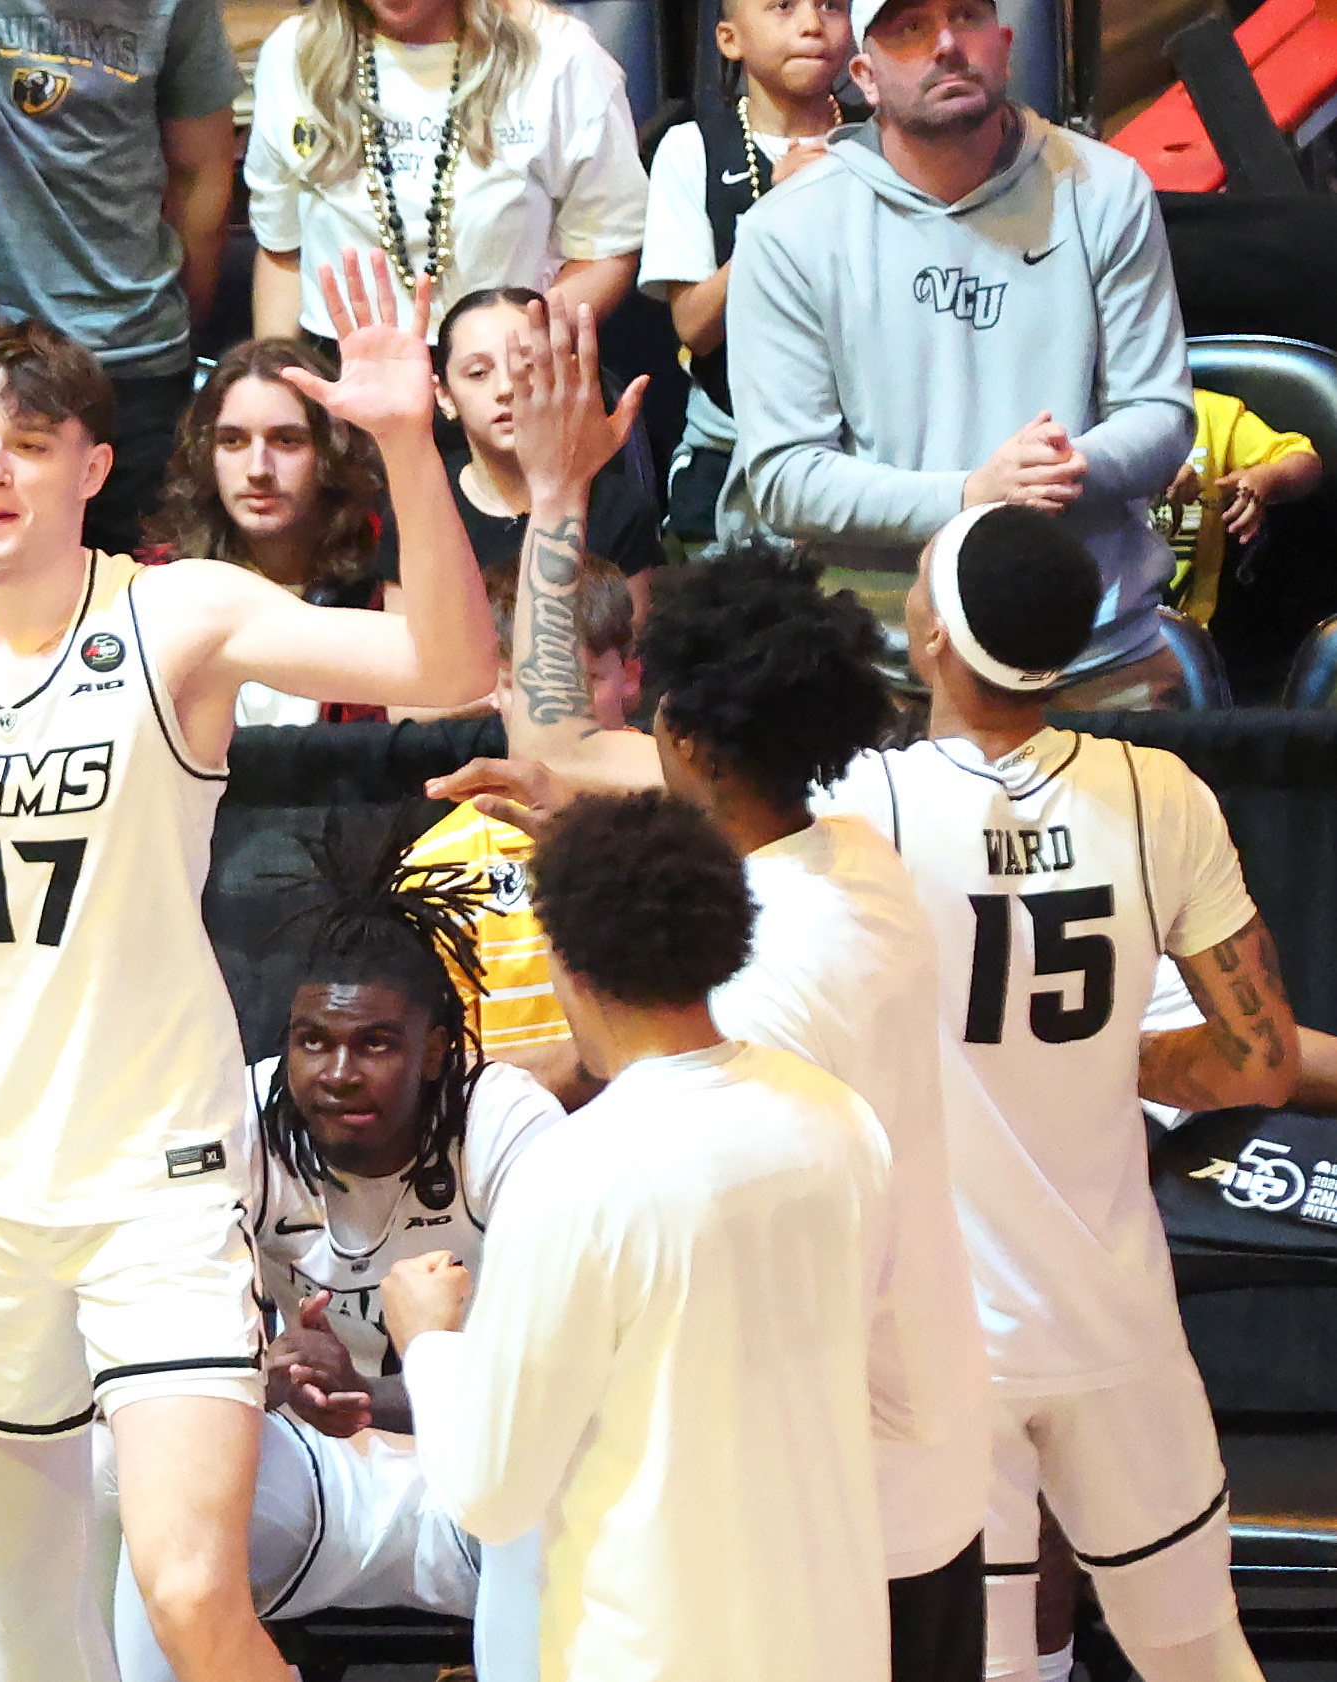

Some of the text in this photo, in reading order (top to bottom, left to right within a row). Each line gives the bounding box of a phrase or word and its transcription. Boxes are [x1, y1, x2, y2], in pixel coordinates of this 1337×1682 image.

[913, 266, 1008, 330] VCU
[983, 825, 1077, 875] WARD
[963, 884, 1116, 1044] 15
